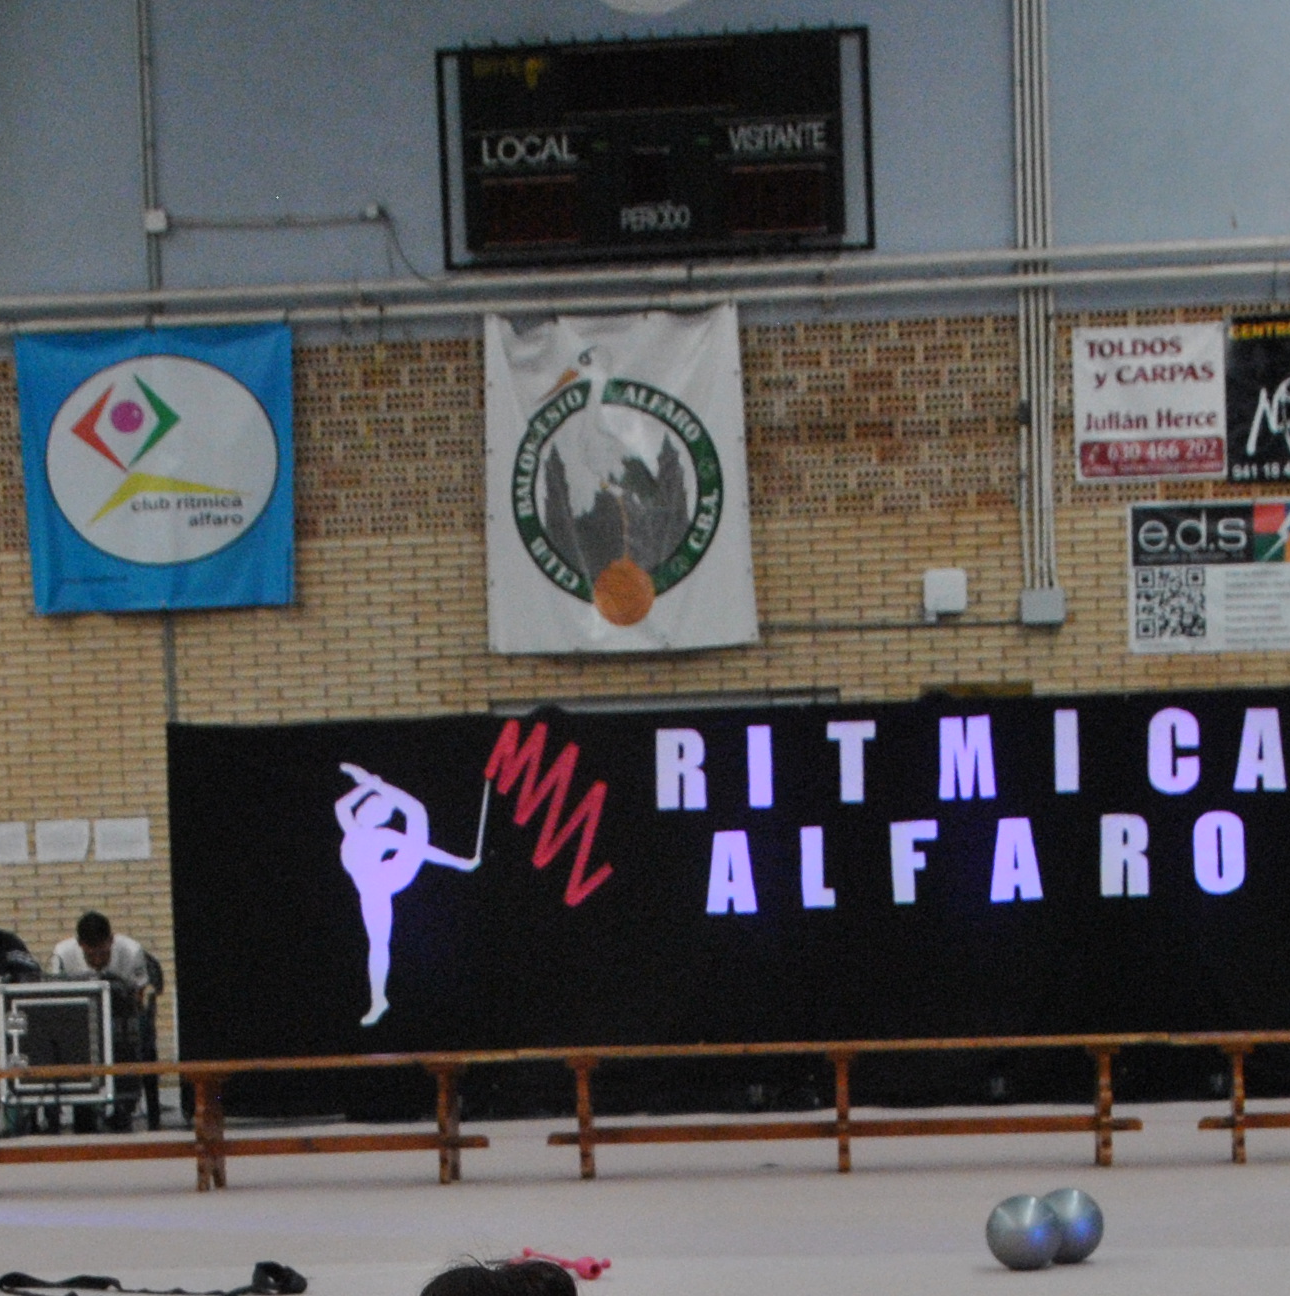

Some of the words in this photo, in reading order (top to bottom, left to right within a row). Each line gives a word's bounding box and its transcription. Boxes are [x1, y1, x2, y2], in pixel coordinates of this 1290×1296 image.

[482, 133, 578, 165] LOCAL
[729, 121, 826, 152] VISITANTE
[1086, 335, 1182, 359] TOLDOS
[1094, 372, 1107, 389] y
[1115, 361, 1215, 385] CARPAS
[624, 384, 702, 443] ALFARO
[1156, 408, 1217, 429] Herce
[131, 495, 170, 513] club
[188, 511, 244, 528] alfaro
